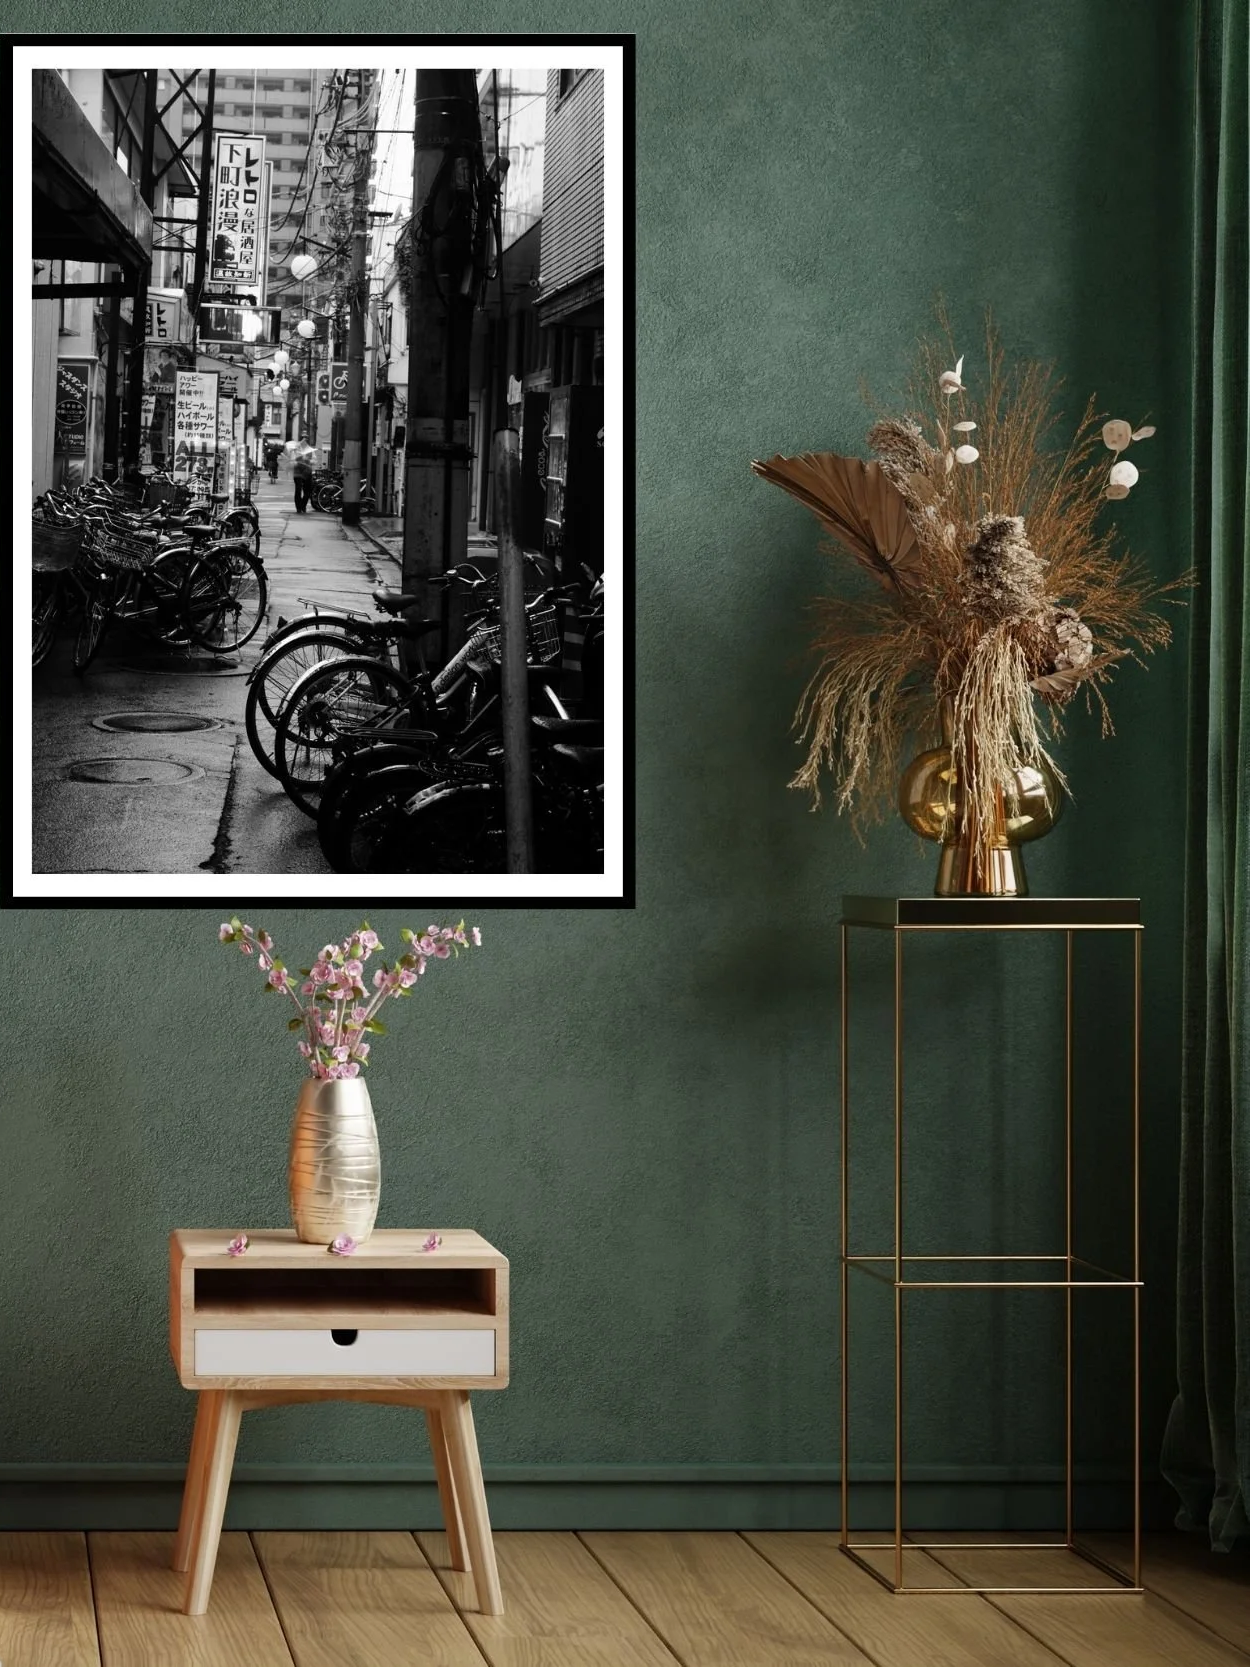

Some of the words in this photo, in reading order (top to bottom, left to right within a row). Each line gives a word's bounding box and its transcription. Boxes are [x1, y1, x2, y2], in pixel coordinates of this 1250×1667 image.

[218, 143, 242, 232] 下町浪漫
[239, 147, 260, 265] レトロな居酒屋
[157, 303, 166, 337] レトロ
[176, 440, 215, 457] ALL
